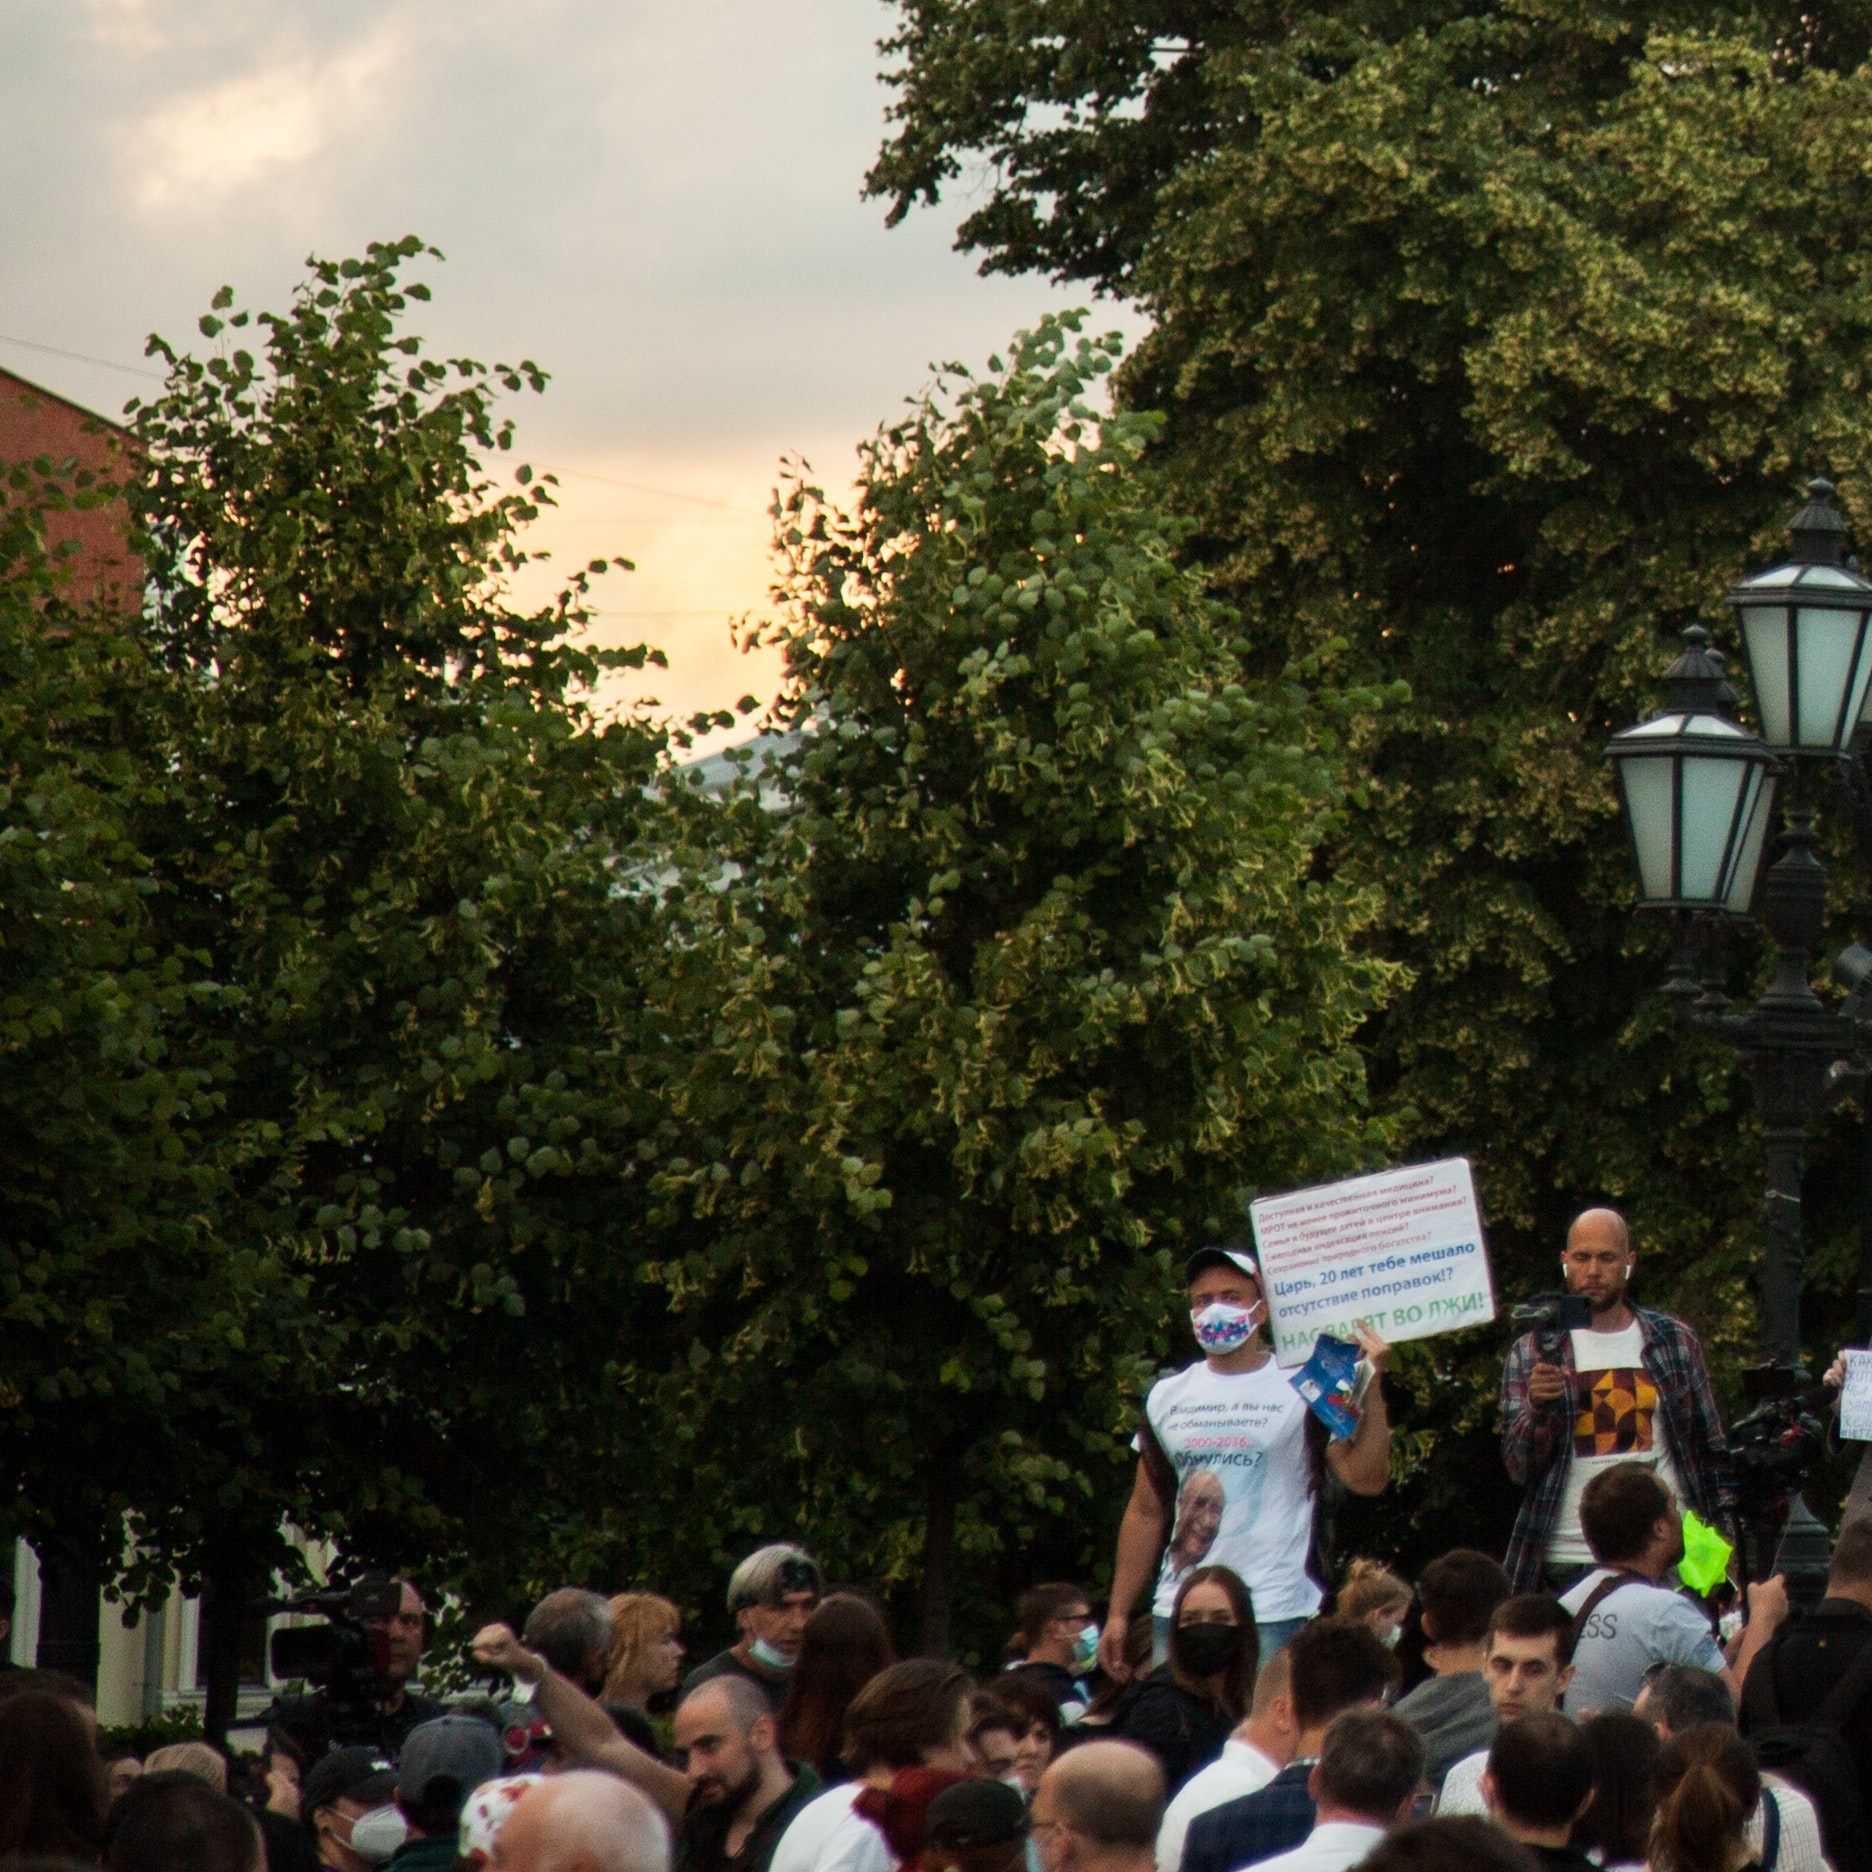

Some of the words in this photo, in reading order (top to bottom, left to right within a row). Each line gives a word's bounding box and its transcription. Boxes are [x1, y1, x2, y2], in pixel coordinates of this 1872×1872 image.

[1380, 1175, 1434, 1194] медицина?
[1261, 1223, 1285, 1234] МРОТ
[1400, 1185, 1457, 1204] минимума?
[1274, 1279, 1316, 1296] Царь,
[1319, 1270, 1337, 1285] 20
[1340, 1265, 1364, 1281] лет
[1368, 1255, 1406, 1273] тебе
[1410, 1242, 1475, 1265] мешало
[1279, 1291, 1358, 1318] отсутствие
[1361, 1267, 1453, 1299] поправок!?
[1392, 1305, 1422, 1327] ВО
[1428, 1291, 1484, 1319] ЛЖИ!
[1180, 1418, 1268, 1429] обманываете?
[1262, 1403, 1284, 1413] нас
